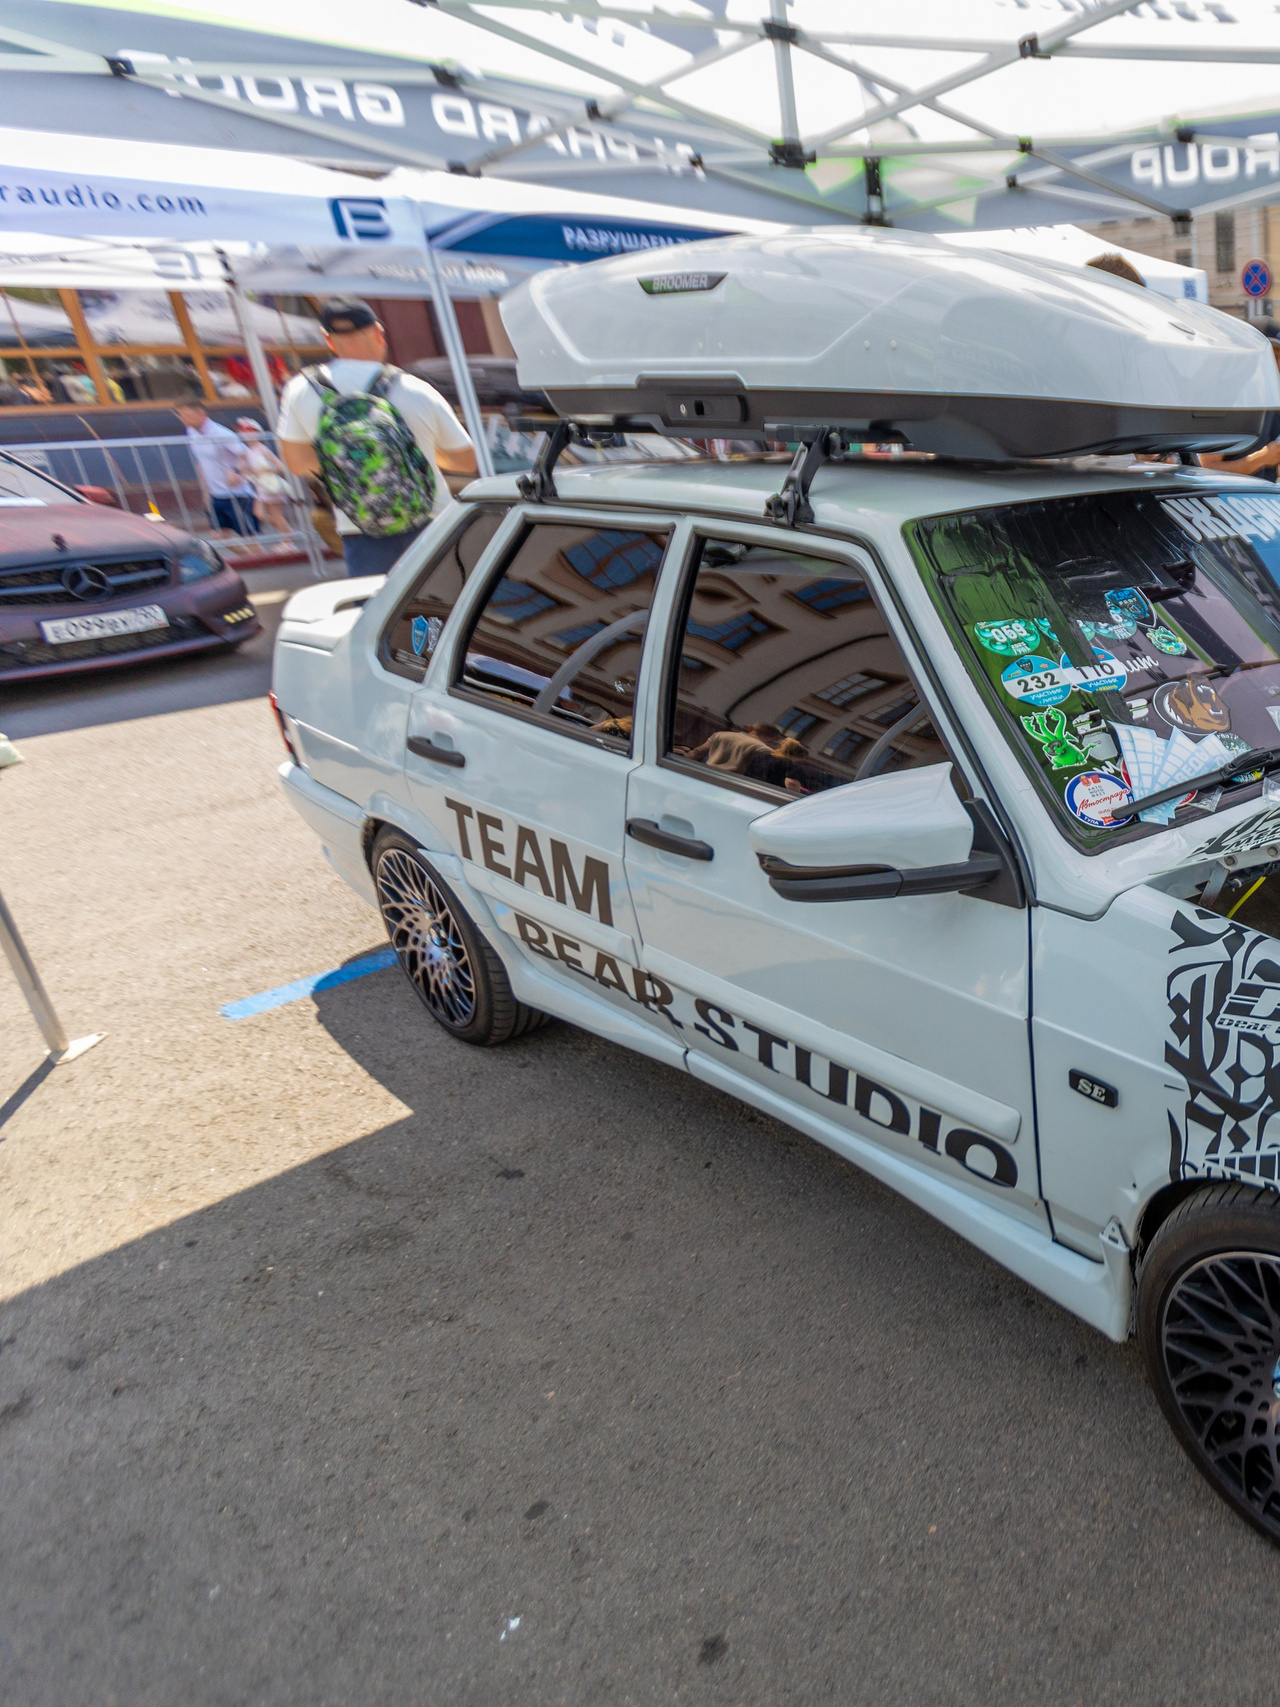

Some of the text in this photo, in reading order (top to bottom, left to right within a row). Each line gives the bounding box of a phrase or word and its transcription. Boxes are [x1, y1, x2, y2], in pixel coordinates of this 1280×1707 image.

[651, 274, 708, 290] BROOMER
[1017, 672, 1060, 692] 232
[1077, 787, 1131, 815] Автострада
[445, 795, 613, 927] TEAM
[514, 911, 1020, 1190] BEAR STUDIO
[1077, 1078, 1106, 1103] SE
